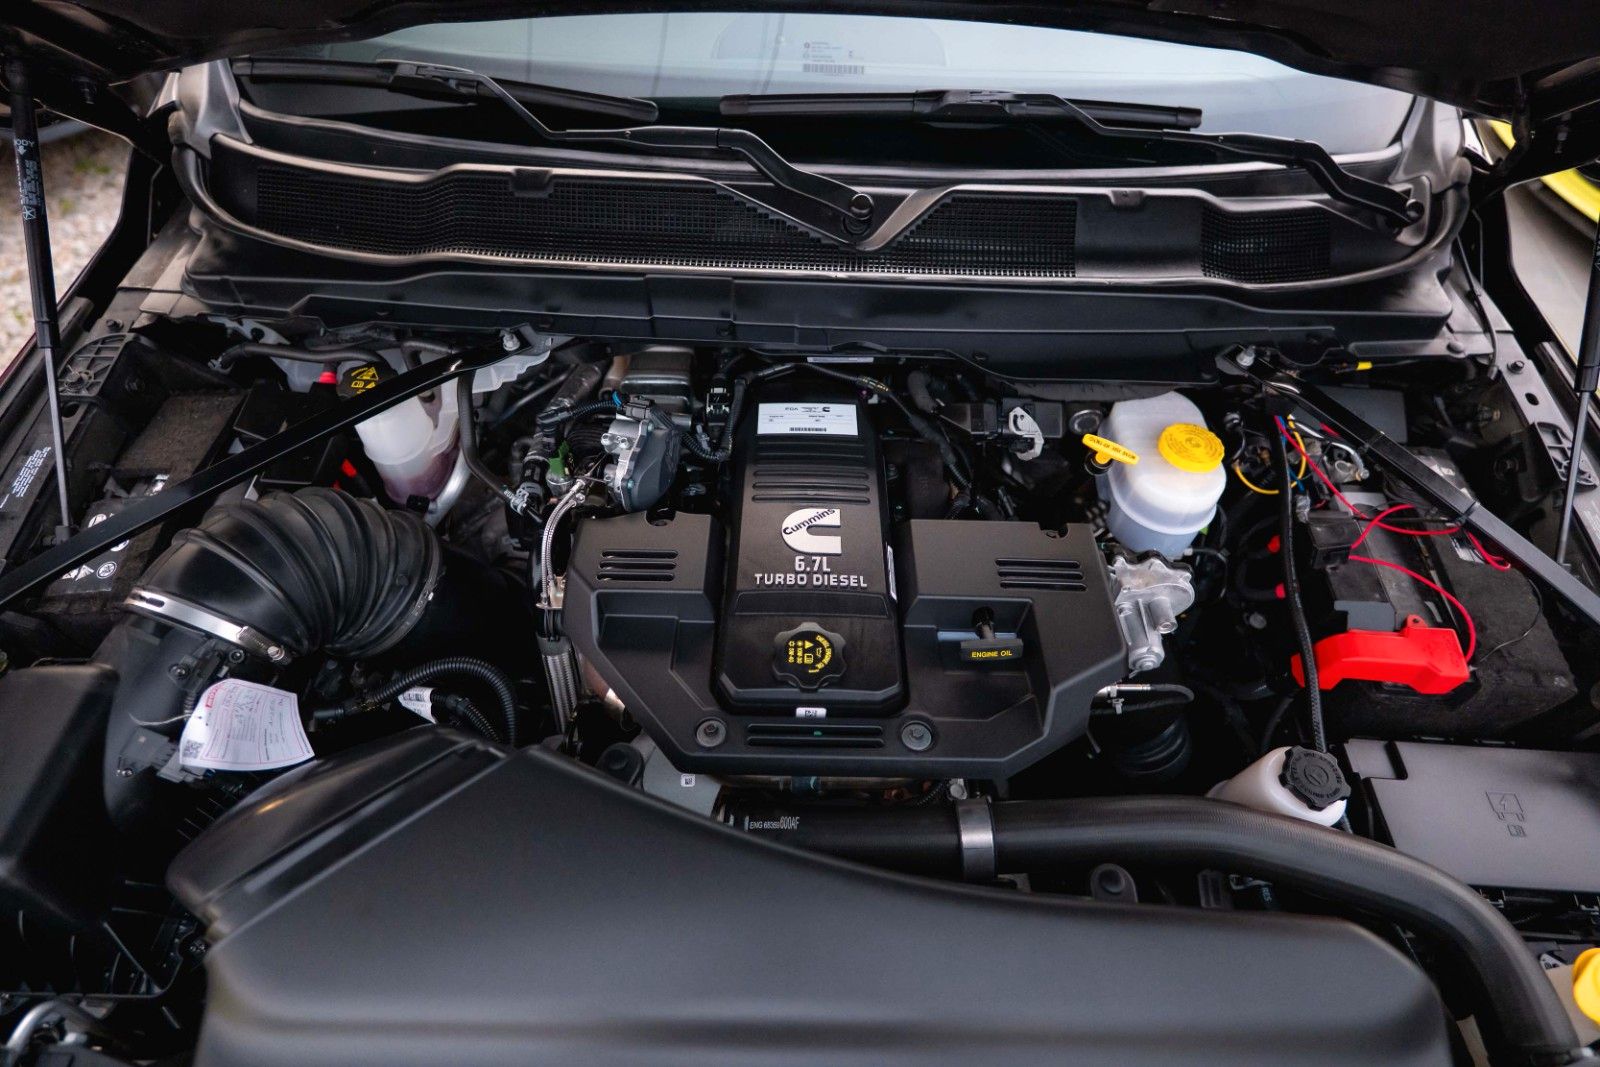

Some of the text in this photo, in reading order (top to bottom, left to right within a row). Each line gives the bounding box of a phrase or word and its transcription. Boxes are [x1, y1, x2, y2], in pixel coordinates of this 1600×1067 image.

[14, 139, 34, 147] ODY
[783, 508, 836, 535] Cummins
[795, 555, 831, 572] 6.7L
[754, 573, 868, 588] TURBO DIESEL
[822, 648, 832, 664] ENGINE
